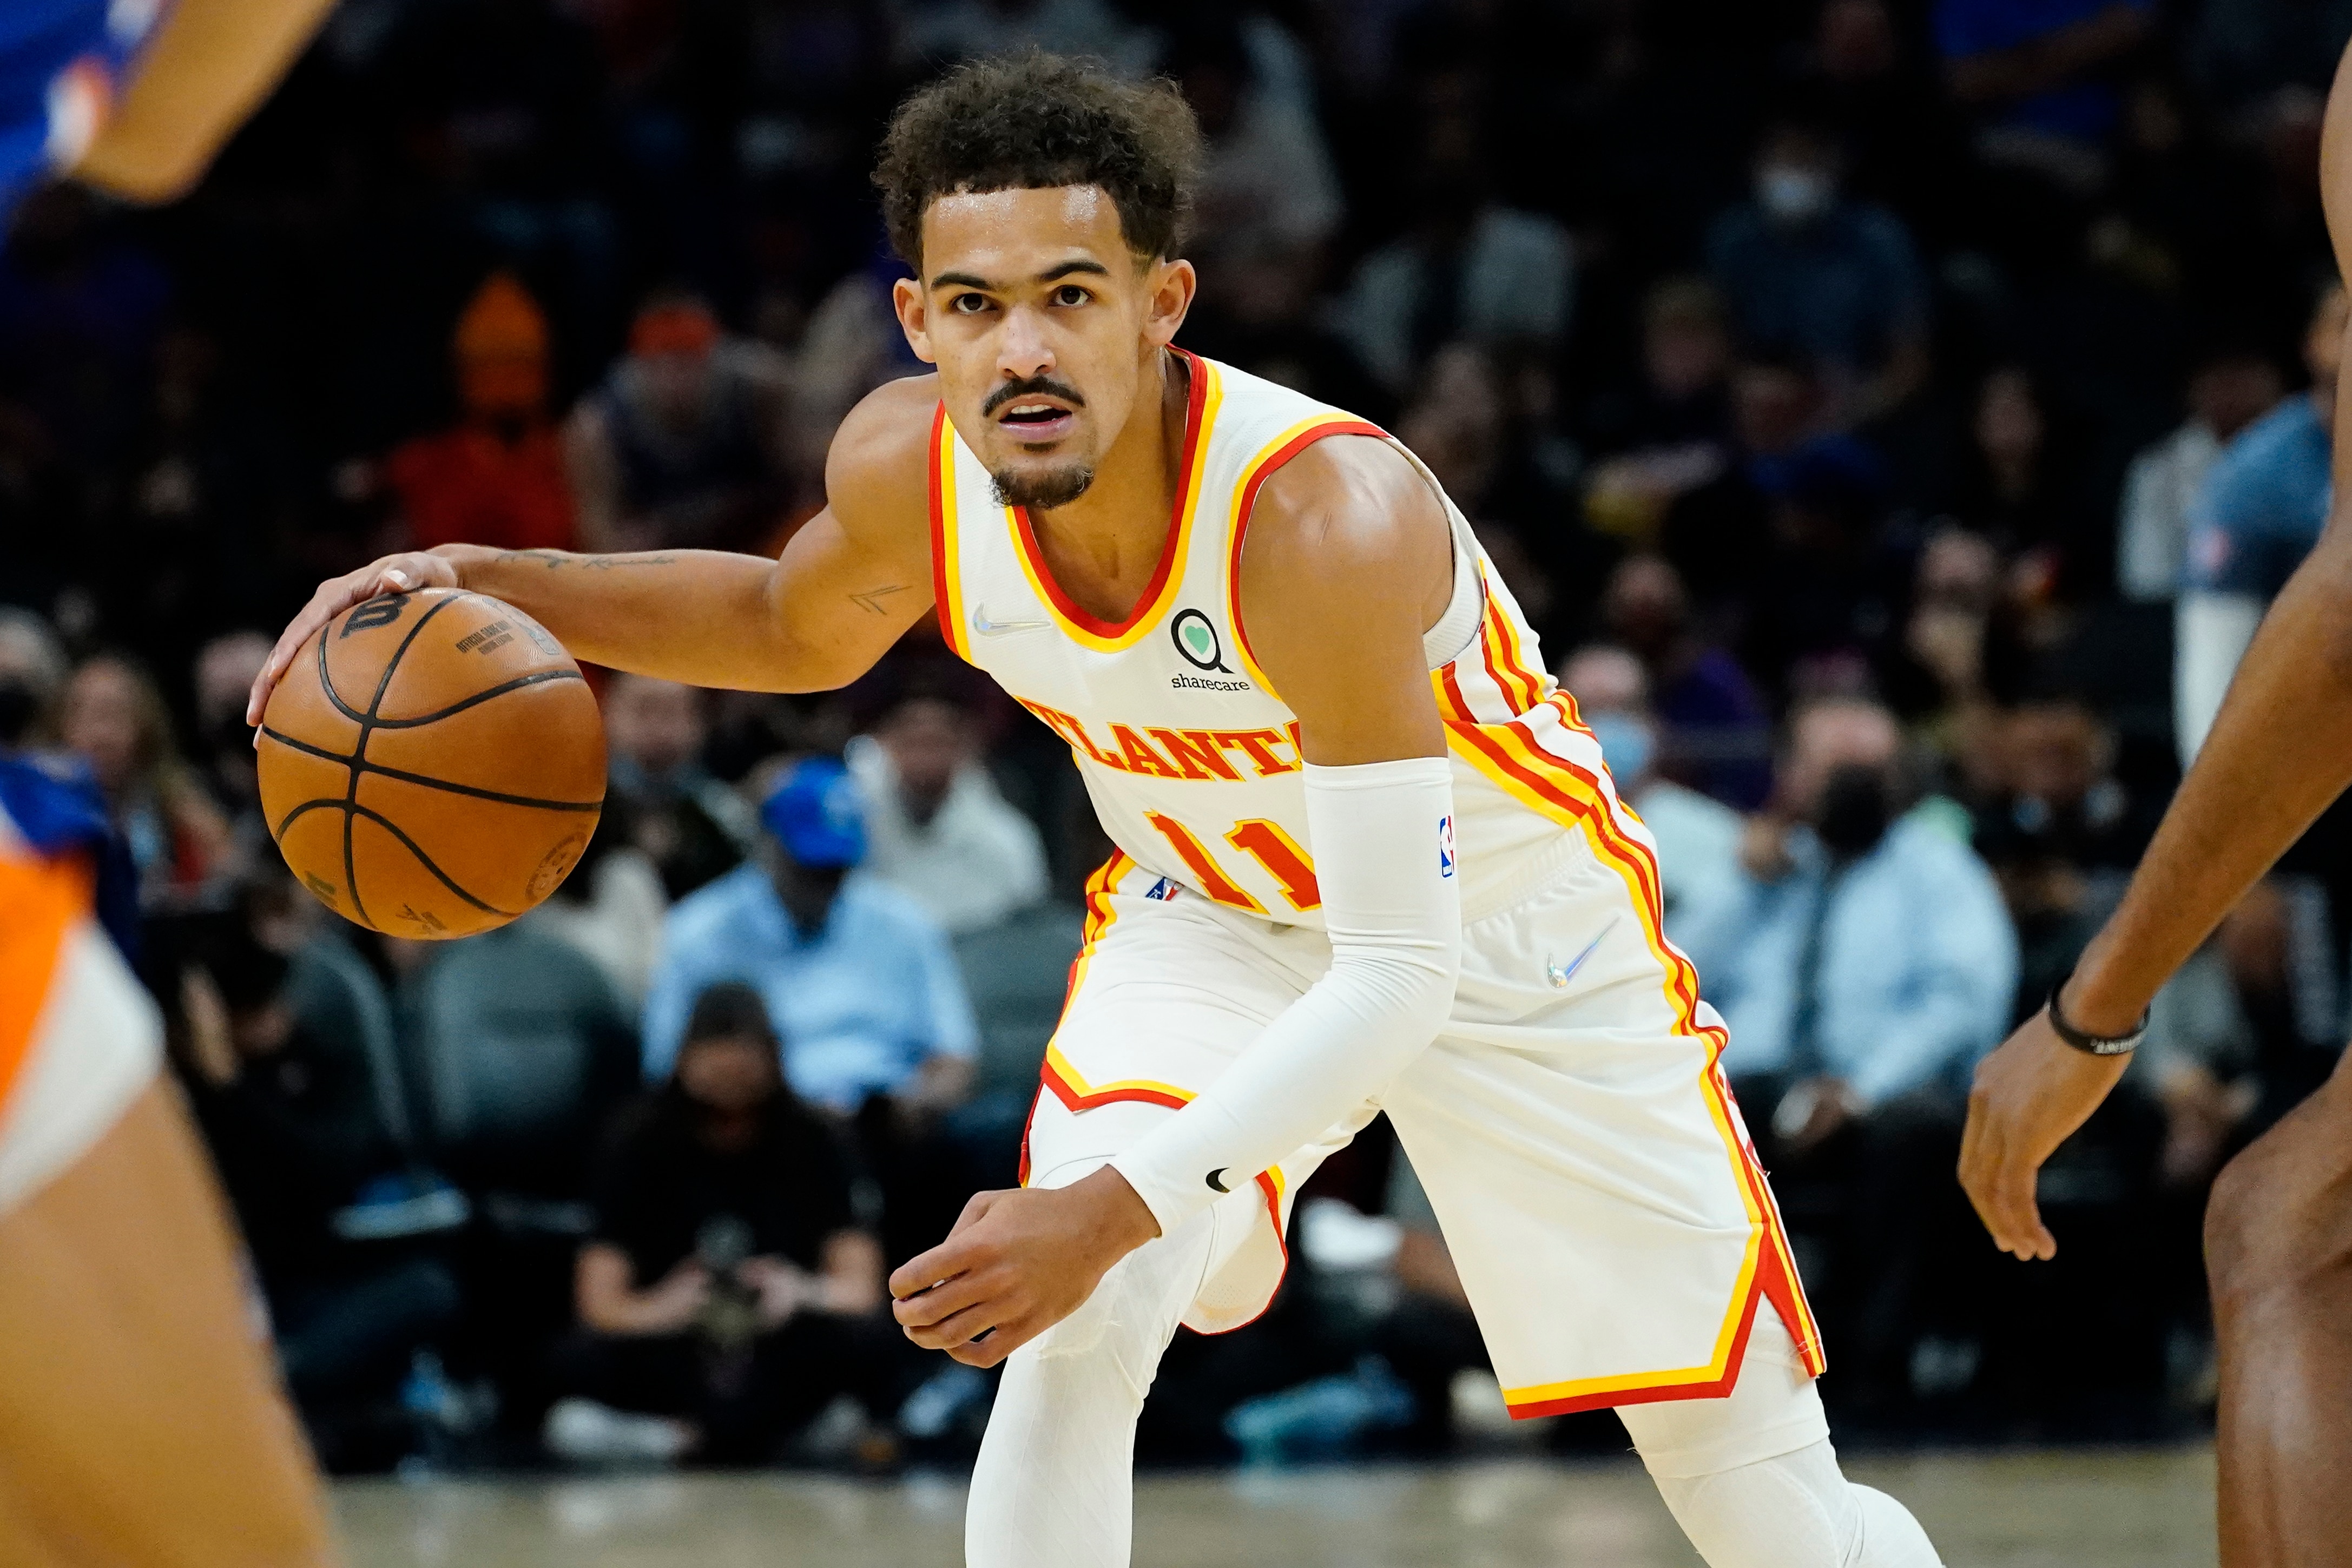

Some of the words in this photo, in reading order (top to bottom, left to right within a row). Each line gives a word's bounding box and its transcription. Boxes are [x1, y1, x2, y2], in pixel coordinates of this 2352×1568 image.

[1171, 674, 1250, 691] sharecare
[1012, 694, 1302, 782] TLANT
[1143, 807, 1321, 914] 11
